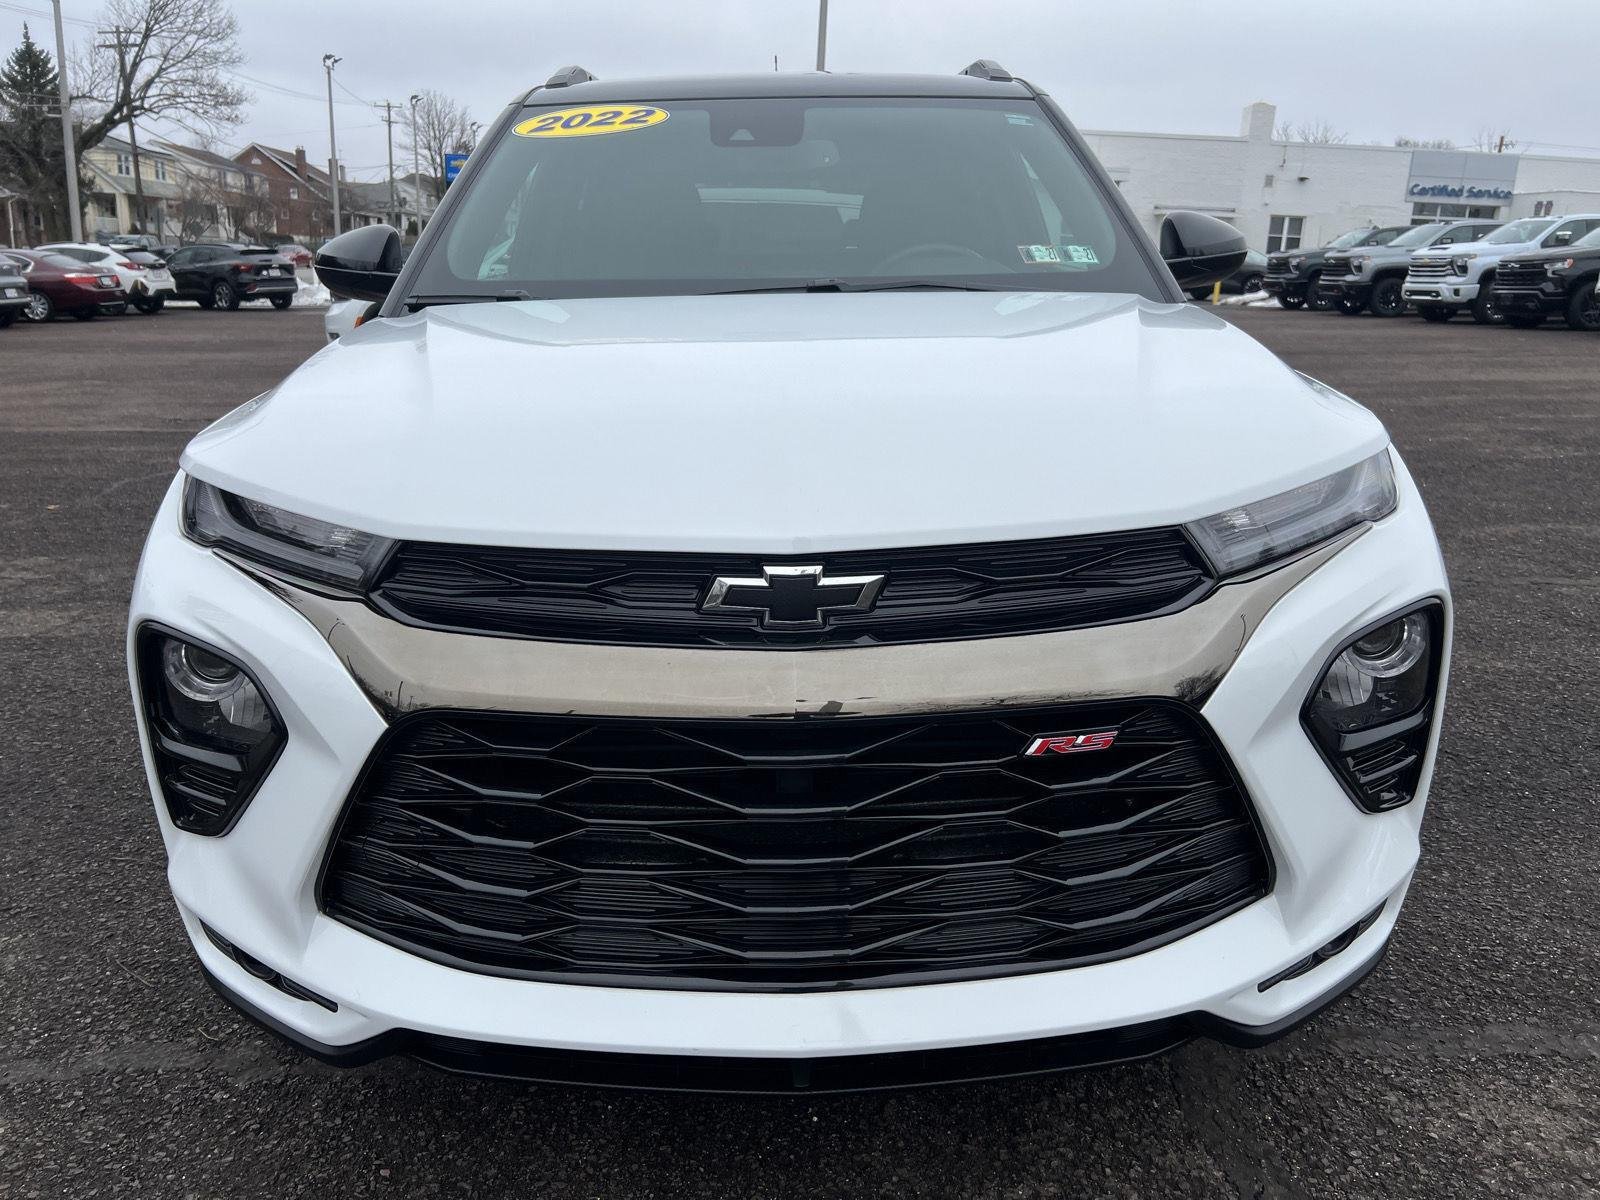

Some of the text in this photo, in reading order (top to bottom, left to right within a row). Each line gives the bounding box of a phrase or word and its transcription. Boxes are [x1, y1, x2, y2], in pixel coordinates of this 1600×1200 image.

[527, 109, 656, 134] 2022
[1409, 184, 1513, 199] Certified Service
[1025, 731, 1118, 756] RS
